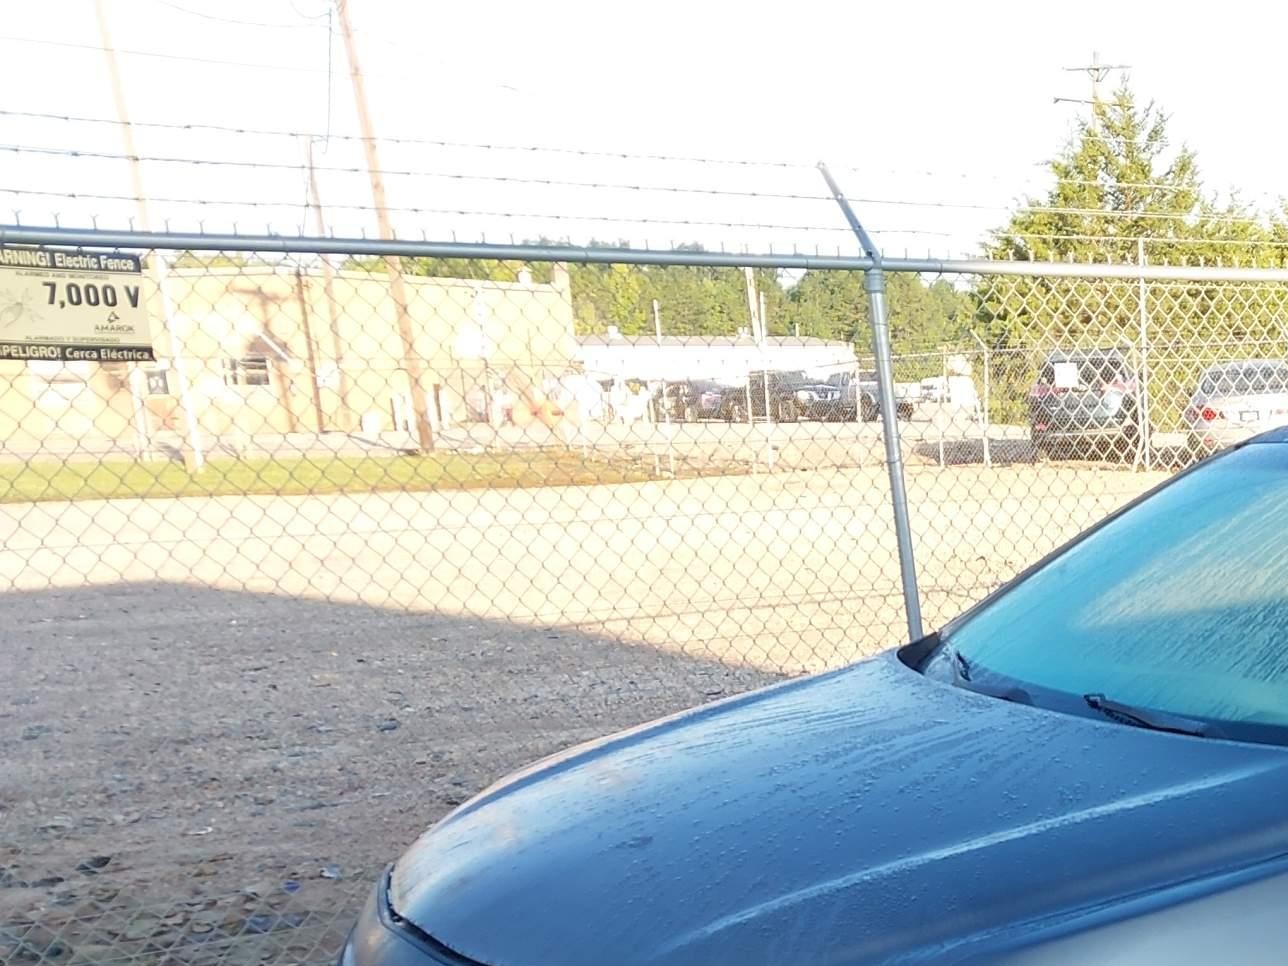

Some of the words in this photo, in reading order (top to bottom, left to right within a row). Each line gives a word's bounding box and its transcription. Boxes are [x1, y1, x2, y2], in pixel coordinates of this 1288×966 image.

[54, 252, 98, 269] Electric
[99, 255, 134, 271] Fence
[42, 281, 118, 309] 7,000
[124, 285, 140, 308] V
[65, 347, 98, 359] Cerca
